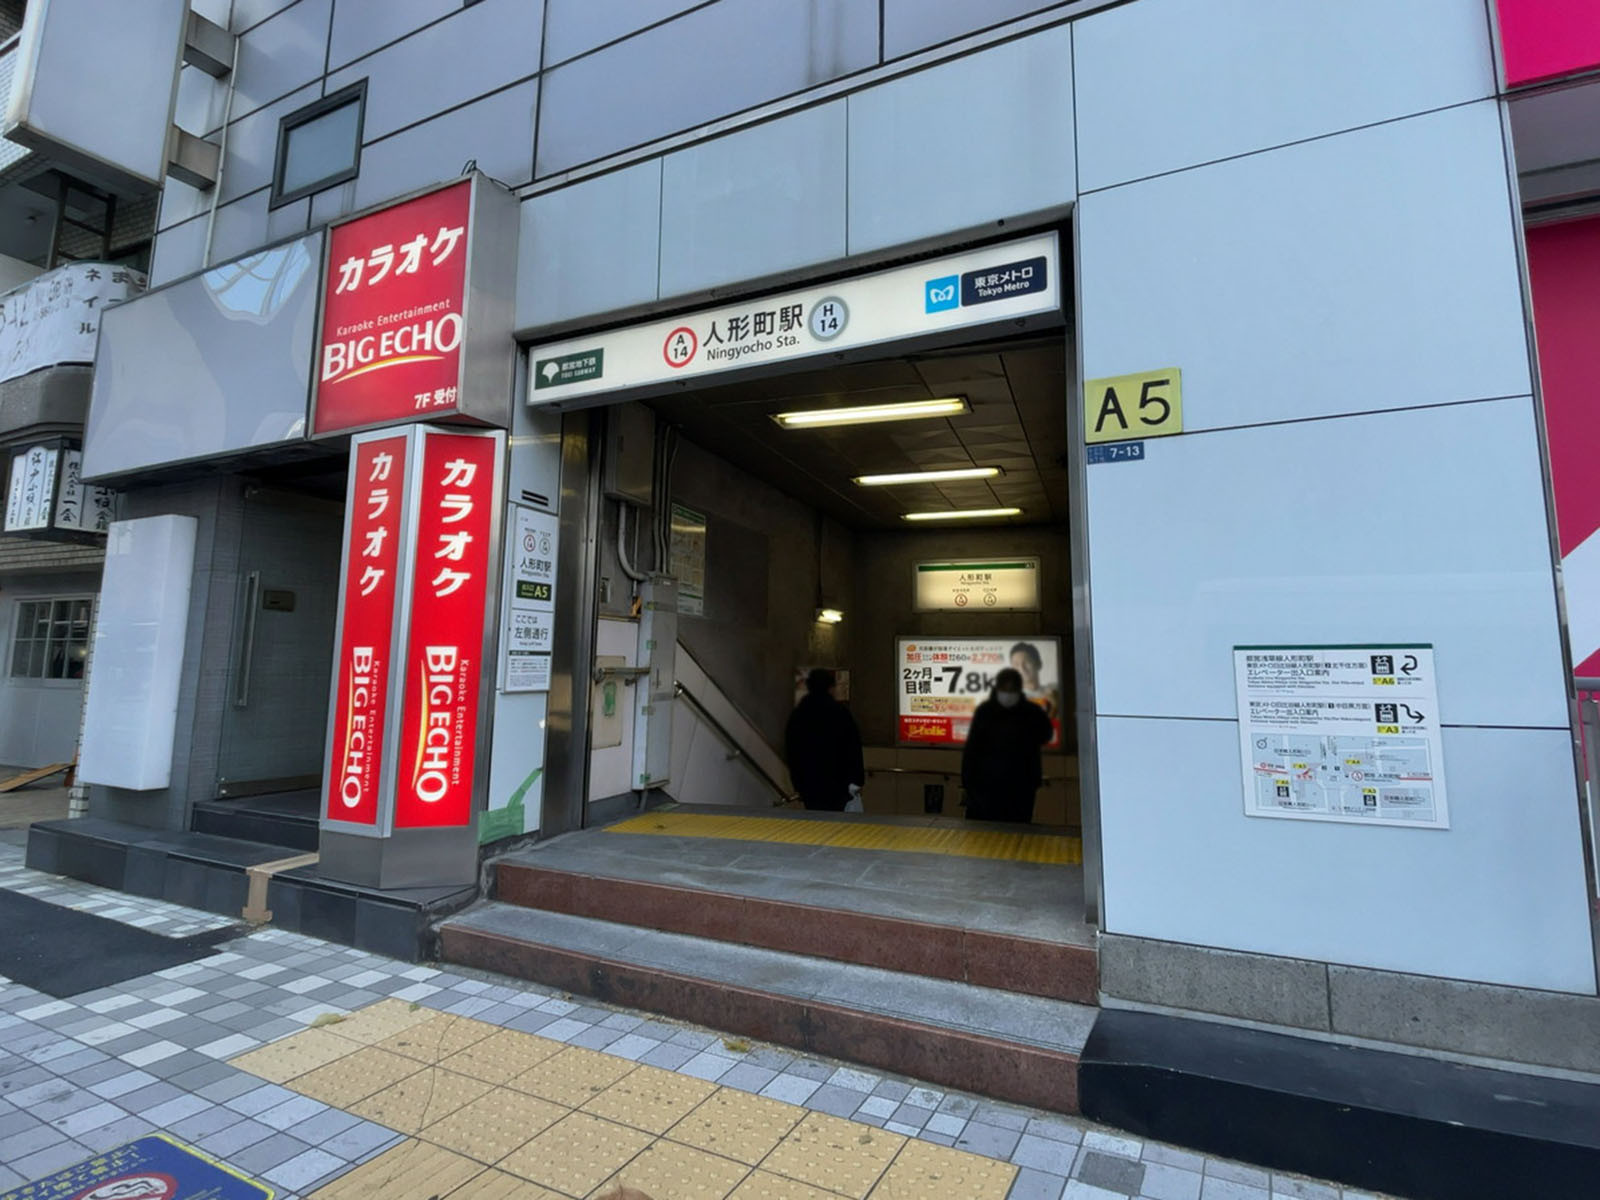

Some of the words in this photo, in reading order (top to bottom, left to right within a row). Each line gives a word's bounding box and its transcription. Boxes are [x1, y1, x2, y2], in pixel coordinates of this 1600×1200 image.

[335, 226, 464, 295] カラオケ
[974, 266, 1033, 289] 東京メトロ
[977, 286, 1003, 298] Tokyo
[1003, 280, 1030, 294] Metro
[79, 268, 102, 334] ネイル
[823, 304, 834, 317] H
[336, 319, 375, 337] Karaoke
[376, 299, 451, 327] Entertainment
[702, 303, 804, 348] 人形町駅
[819, 317, 839, 333] 14
[321, 336, 375, 382] BIG
[379, 312, 464, 356] ECHO
[672, 346, 688, 360] 14
[676, 334, 686, 346] A
[706, 338, 773, 362] Ningyocho
[776, 332, 801, 348] Sta.
[561, 356, 597, 371] 都営地下鉄
[414, 392, 431, 410] 7F
[434, 386, 457, 406] 受付
[1109, 445, 1140, 459] 7-13
[359, 451, 393, 597] カラオケ
[431, 458, 478, 598] カラオケ
[520, 557, 552, 573] 人形町駅
[534, 585, 548, 599] A5
[353, 646, 374, 708] BIG
[369, 660, 381, 706] Karaoke
[425, 646, 459, 706] BIG
[457, 659, 470, 703] Karaoke
[903, 667, 933, 680] 2ヶ月
[905, 681, 932, 694] 目標
[1247, 669, 1330, 677] エレベーター出入口案内
[1250, 709, 1319, 717] エレベーター出入口案内
[363, 709, 377, 793] Entertainment
[416, 711, 451, 803] ECHO
[451, 705, 466, 786] Entertainment
[341, 715, 367, 808] ECHO
